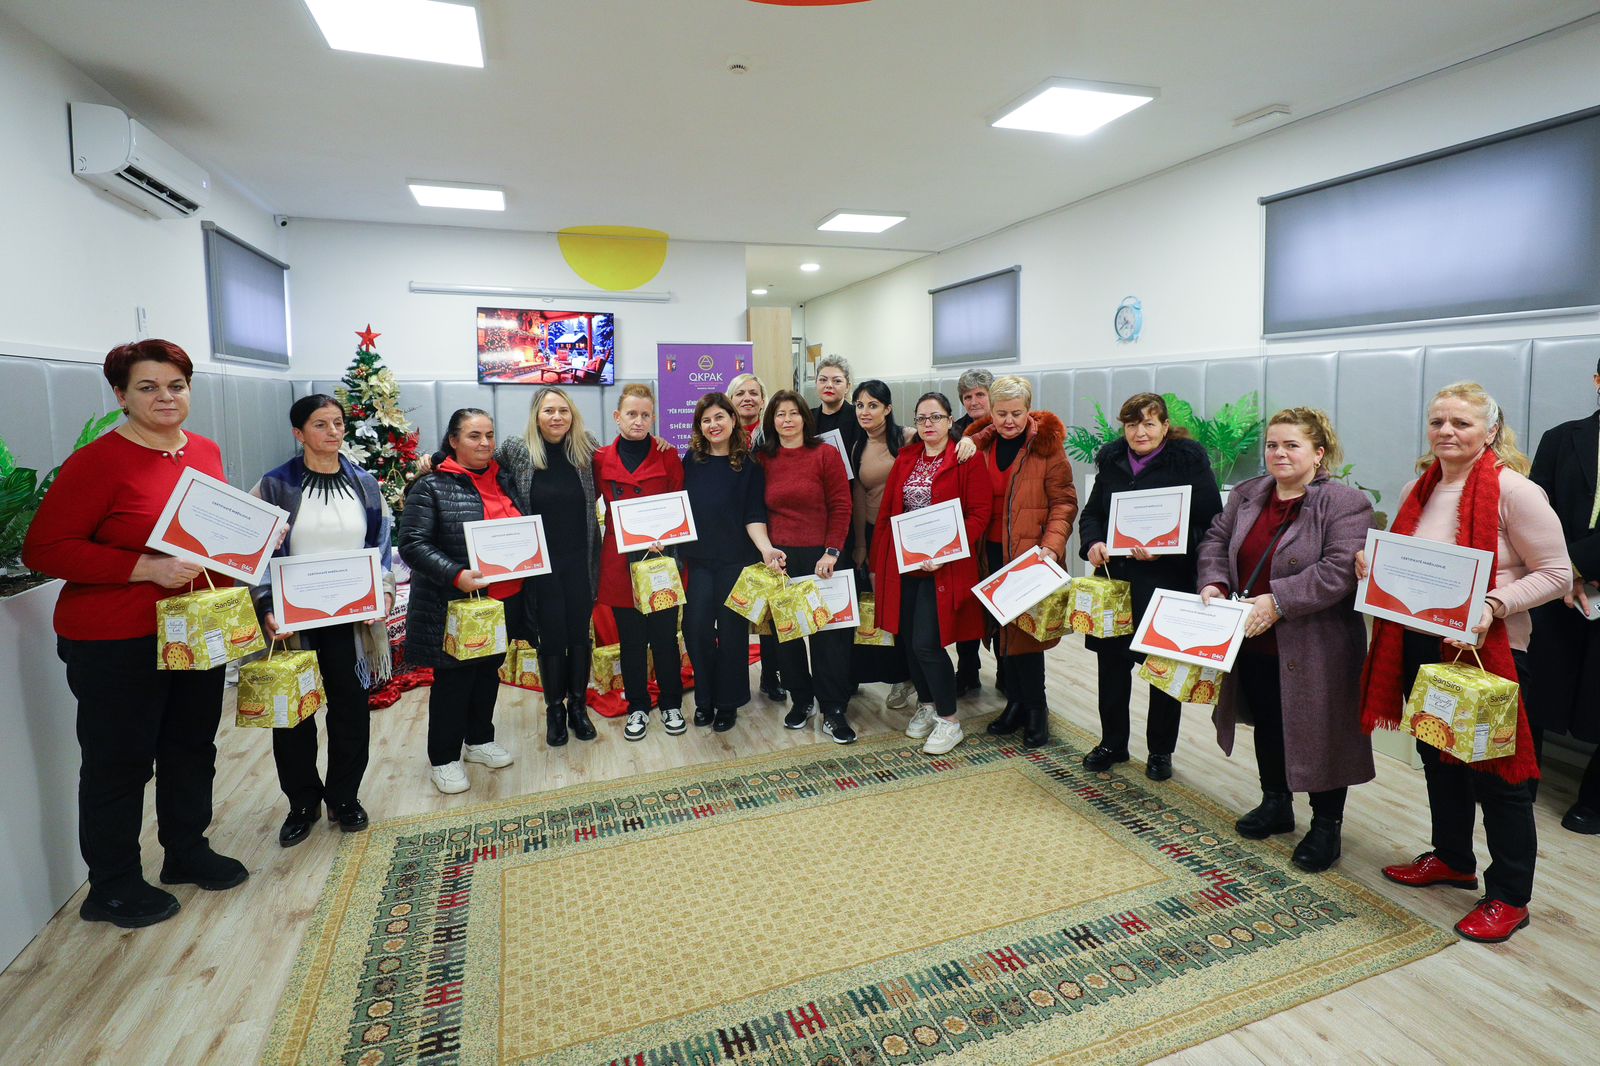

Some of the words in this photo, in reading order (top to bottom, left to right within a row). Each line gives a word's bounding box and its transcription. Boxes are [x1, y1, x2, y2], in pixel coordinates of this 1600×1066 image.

[689, 372, 723, 381] QKPAK
[214, 598, 239, 610] SanSiro
[1432, 674, 1461, 692] SanSiro
[1490, 694, 1511, 703] SanSiro
